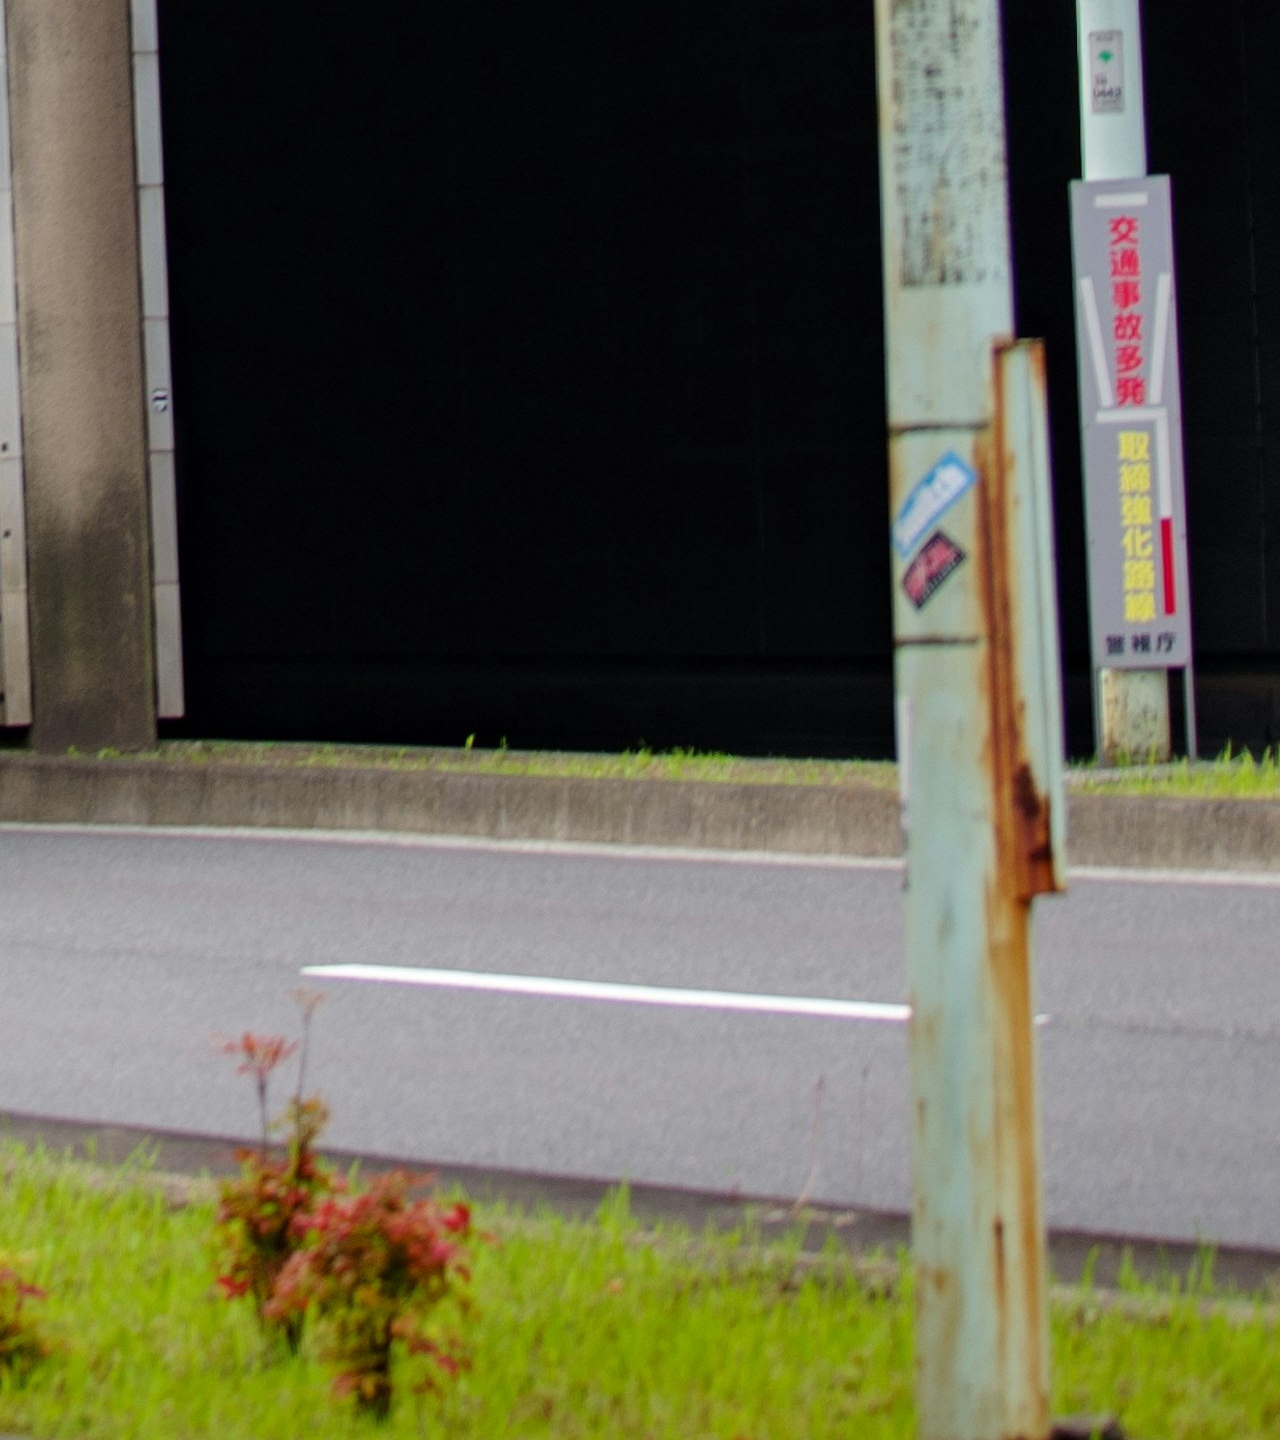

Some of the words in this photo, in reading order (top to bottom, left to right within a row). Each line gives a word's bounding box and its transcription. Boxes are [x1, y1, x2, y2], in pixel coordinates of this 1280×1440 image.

[1108, 214, 1146, 408] 交通事故多発
